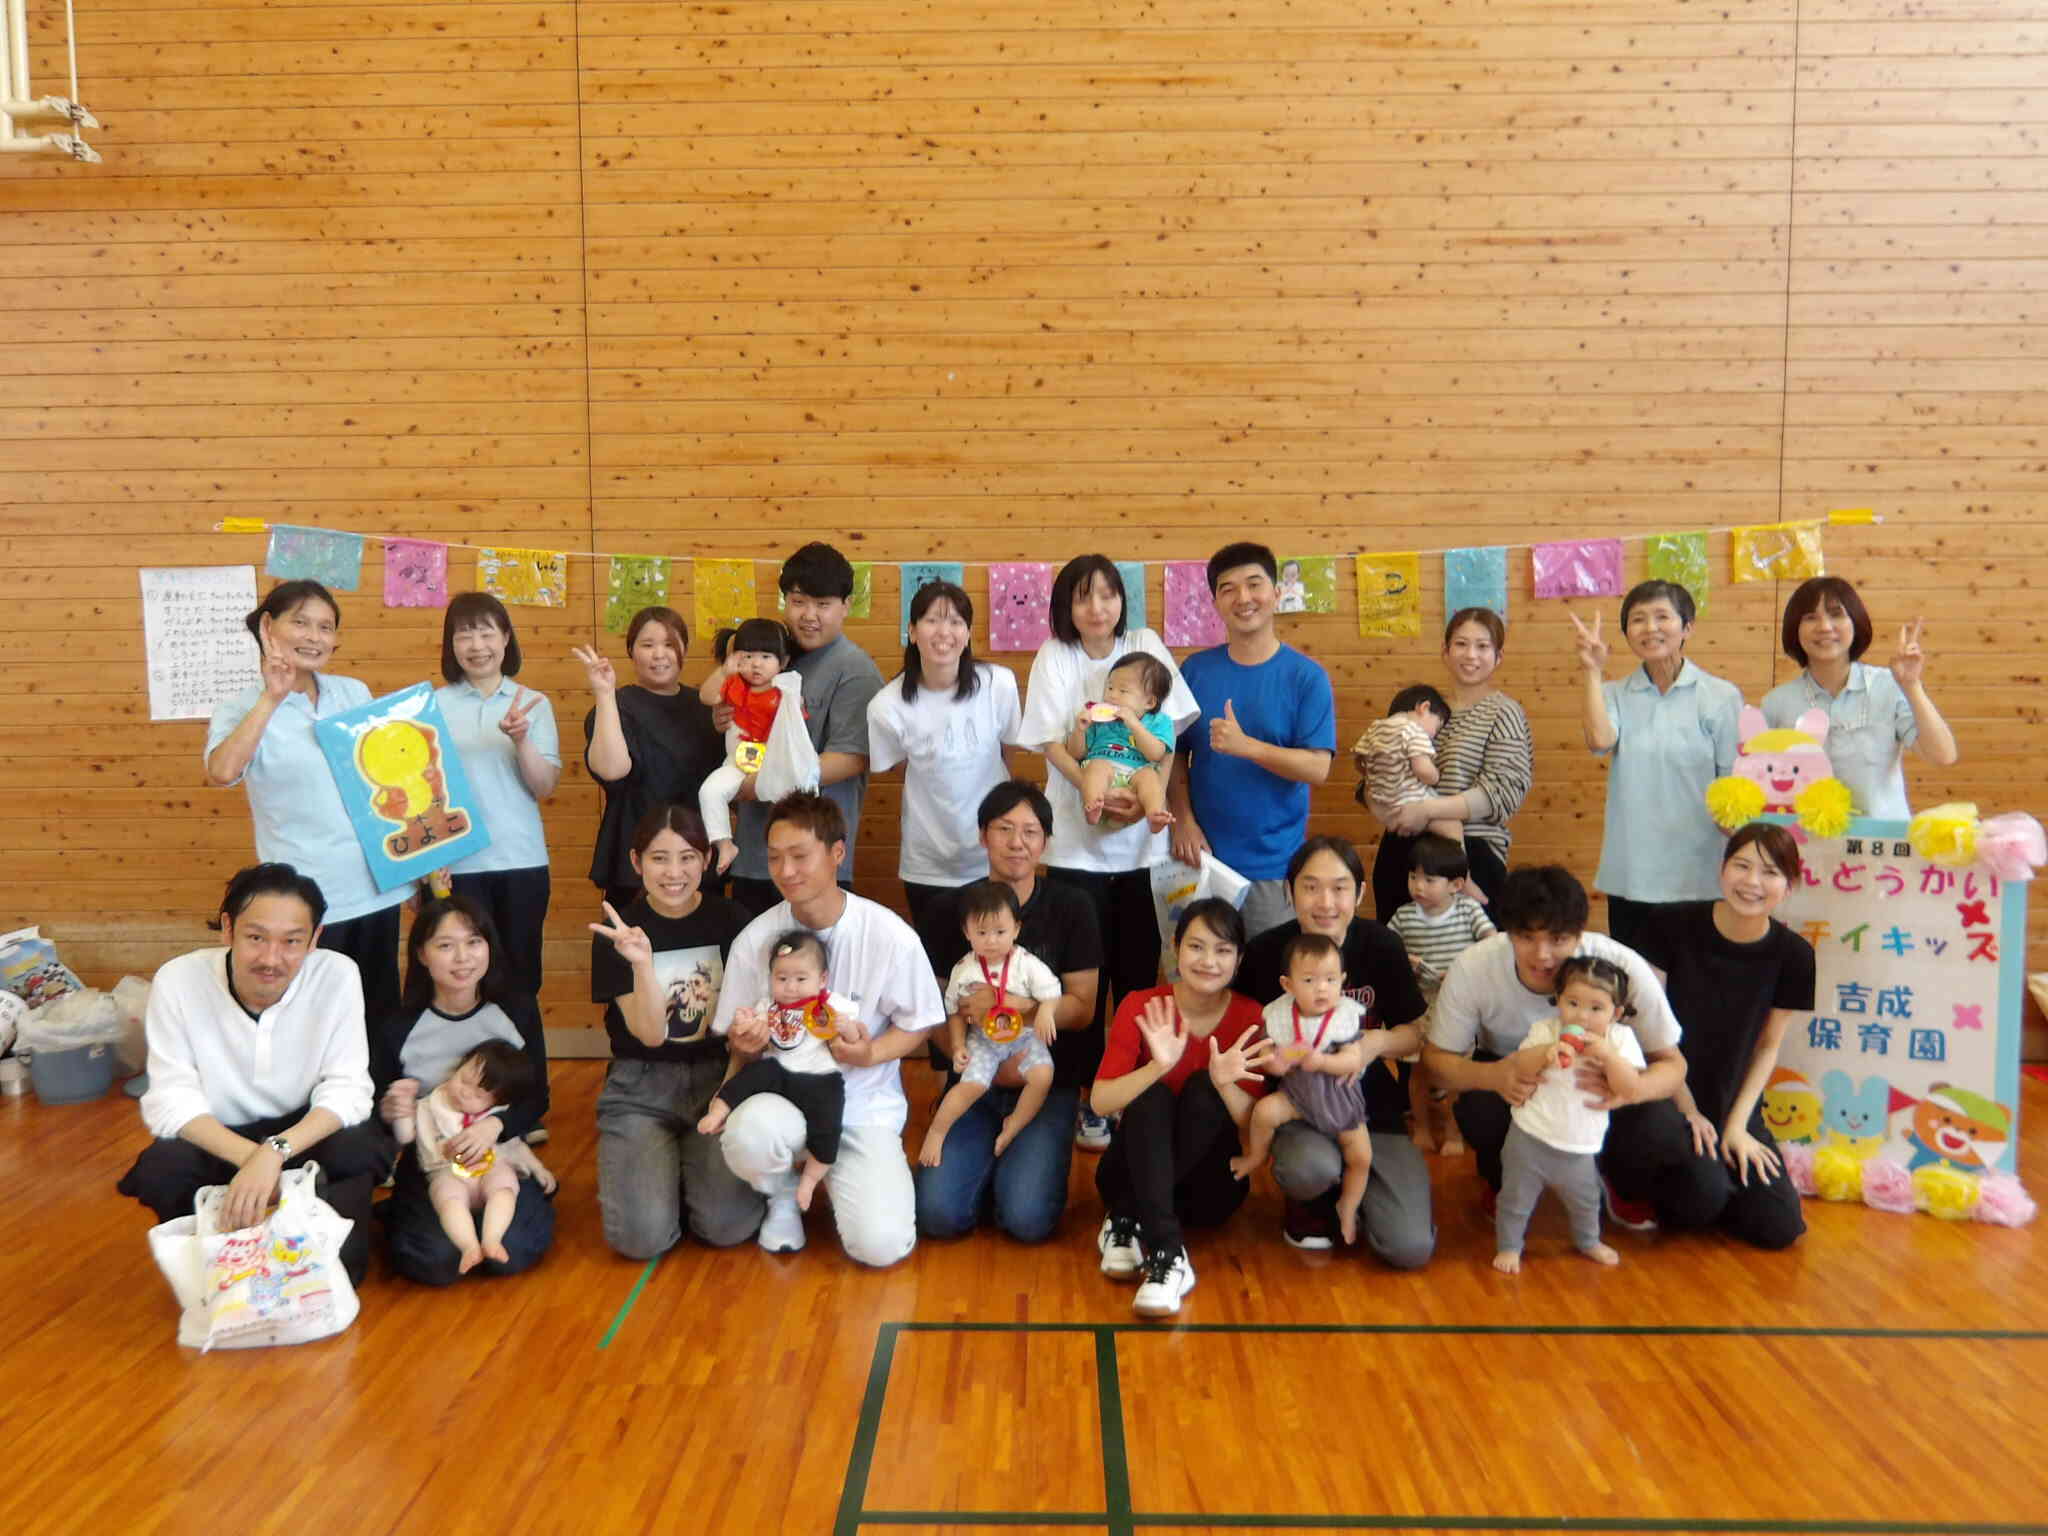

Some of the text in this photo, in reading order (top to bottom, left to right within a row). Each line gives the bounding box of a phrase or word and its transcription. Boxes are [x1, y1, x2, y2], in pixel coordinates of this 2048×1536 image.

[391, 815, 464, 854] ひよこ
[1781, 921, 1998, 962] チイキッズ
[1836, 982, 1913, 1020] 吉成
[1807, 1016, 1946, 1061] 保育園
